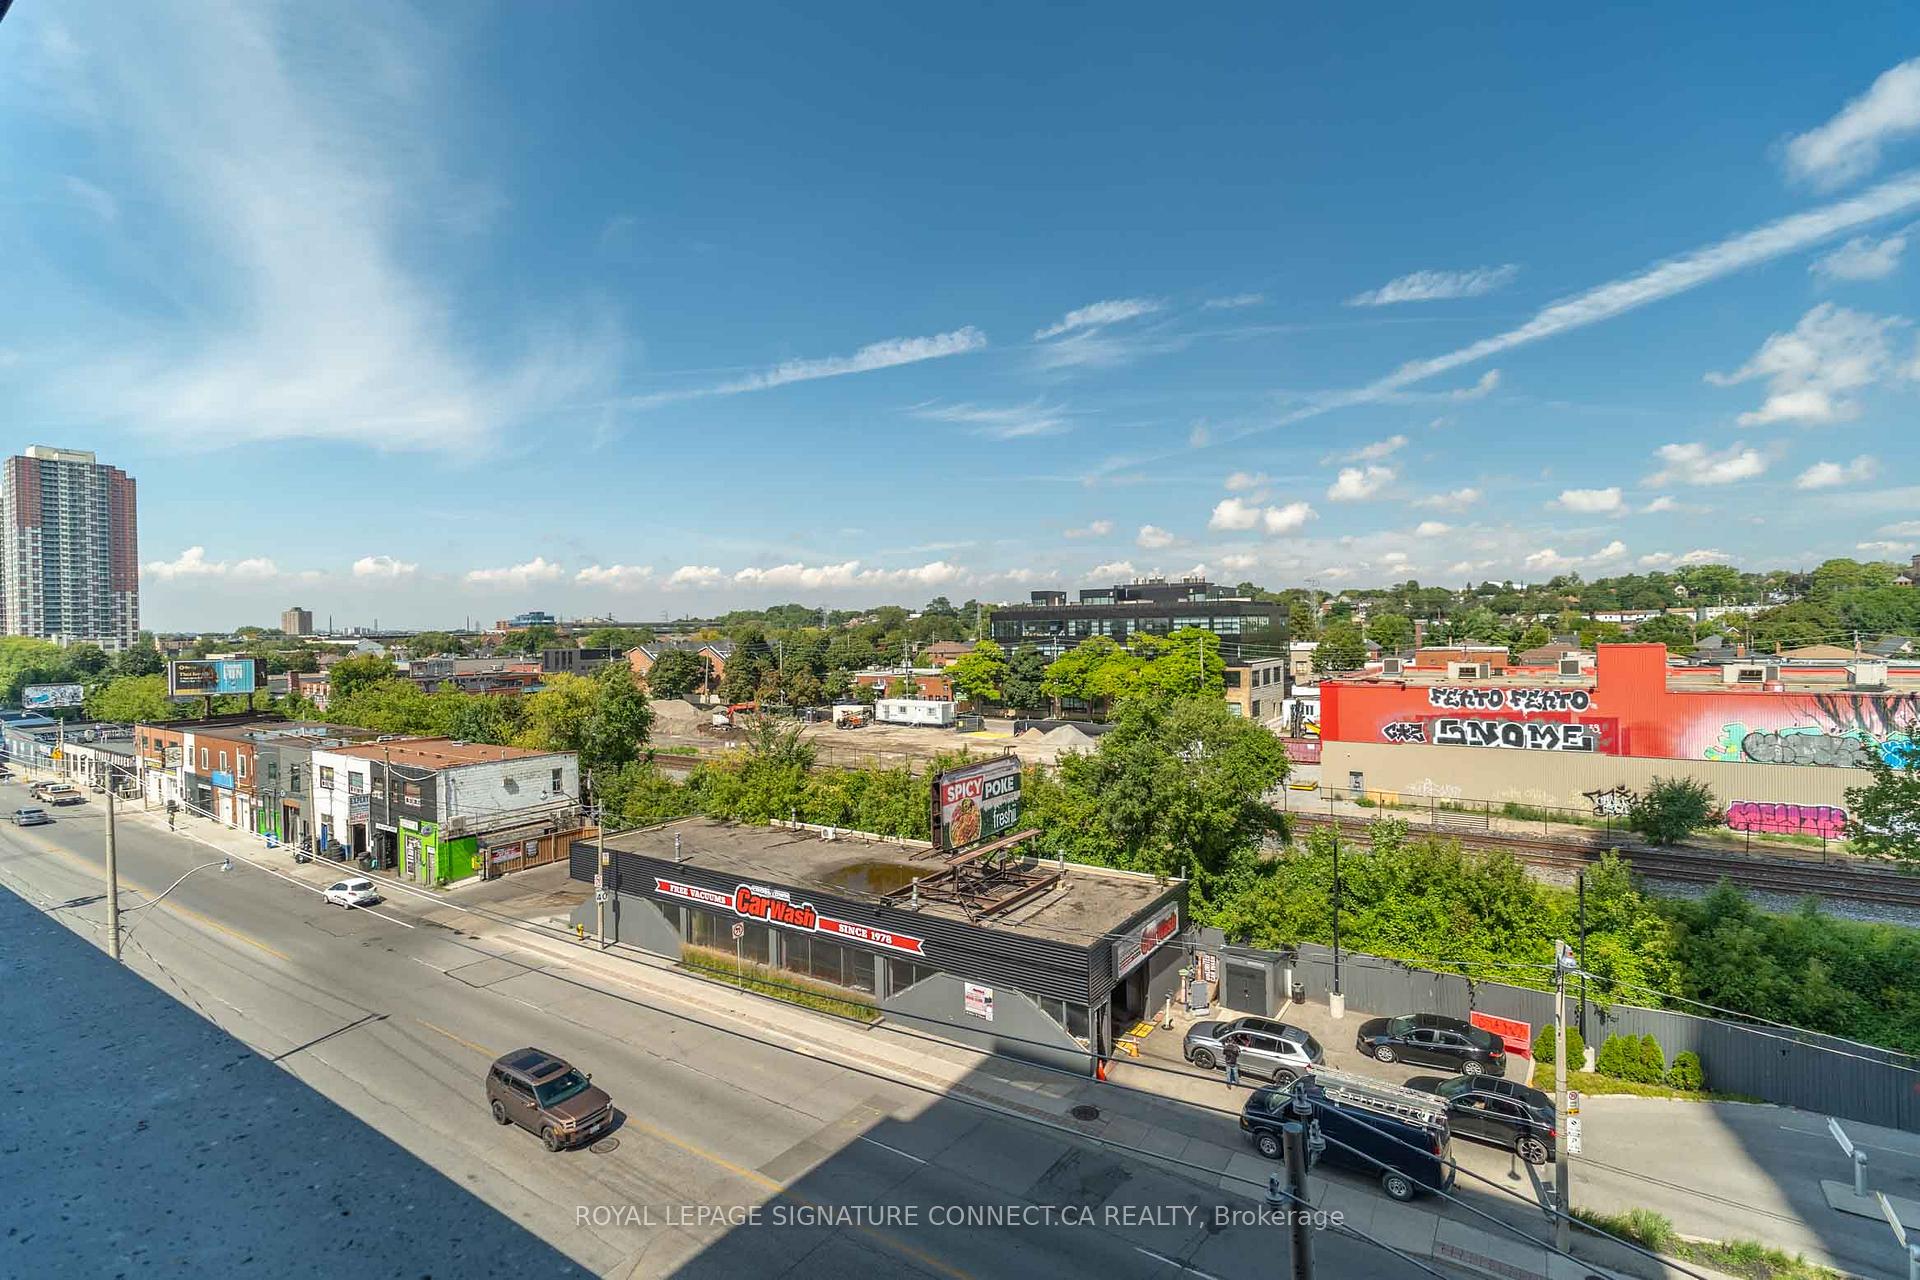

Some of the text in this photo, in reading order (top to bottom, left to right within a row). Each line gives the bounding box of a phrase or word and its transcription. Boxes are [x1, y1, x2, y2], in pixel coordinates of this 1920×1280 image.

[947, 776, 1014, 801] SPICY POKE
[993, 803, 1017, 829] freshii
[669, 884, 726, 904] FREE VACUUMS
[838, 924, 893, 944] SINCE 1978
